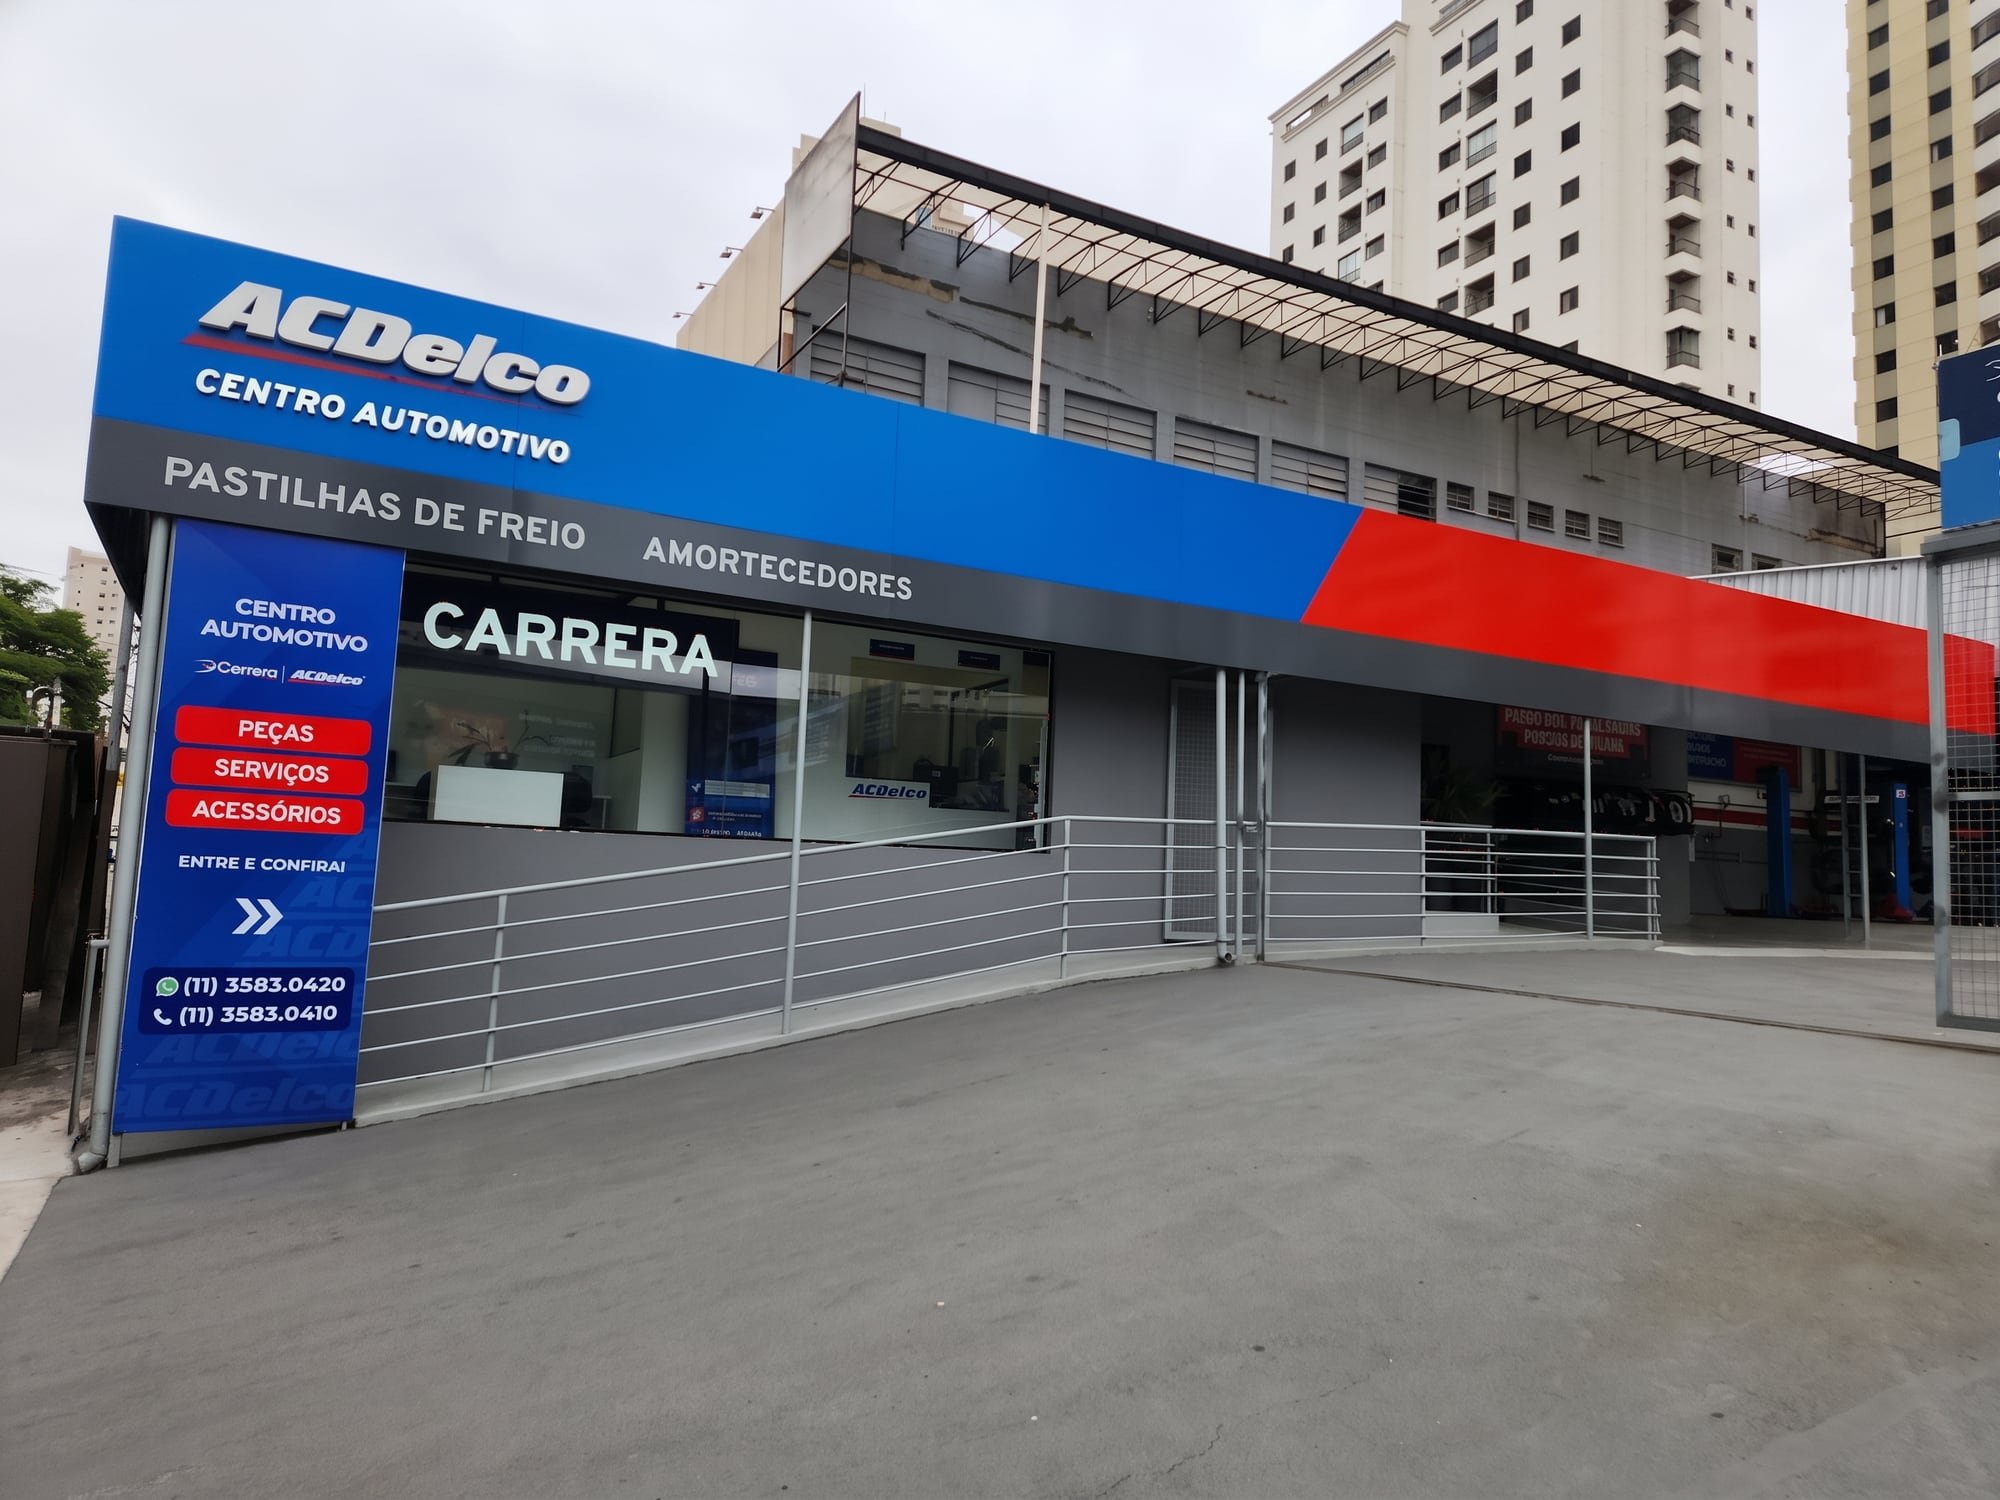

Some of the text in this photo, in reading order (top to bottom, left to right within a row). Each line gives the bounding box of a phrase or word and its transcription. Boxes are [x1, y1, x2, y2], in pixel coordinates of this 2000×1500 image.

[198, 281, 591, 405] ACDelco
[195, 369, 571, 464] CENTRO AUTOMOTIVO
[164, 456, 913, 601] PASTILHAS DE FREIO AMORTECEDORES
[235, 598, 336, 625] CENTRO
[200, 619, 368, 652] AUTOMOTIVO
[423, 601, 719, 678] CARRERA
[291, 669, 364, 686] ACDelco
[238, 719, 314, 744] PEÇAS
[214, 759, 329, 785] SERVIÇOS
[852, 783, 927, 799] ACDelco
[192, 800, 341, 824] ACESSÓRIOS
[178, 855, 239, 870] ENTRE
[245, 857, 256, 870] E
[183, 976, 346, 996] (11) 3583.0420
[179, 1005, 338, 1027] (11) 3583.0410
